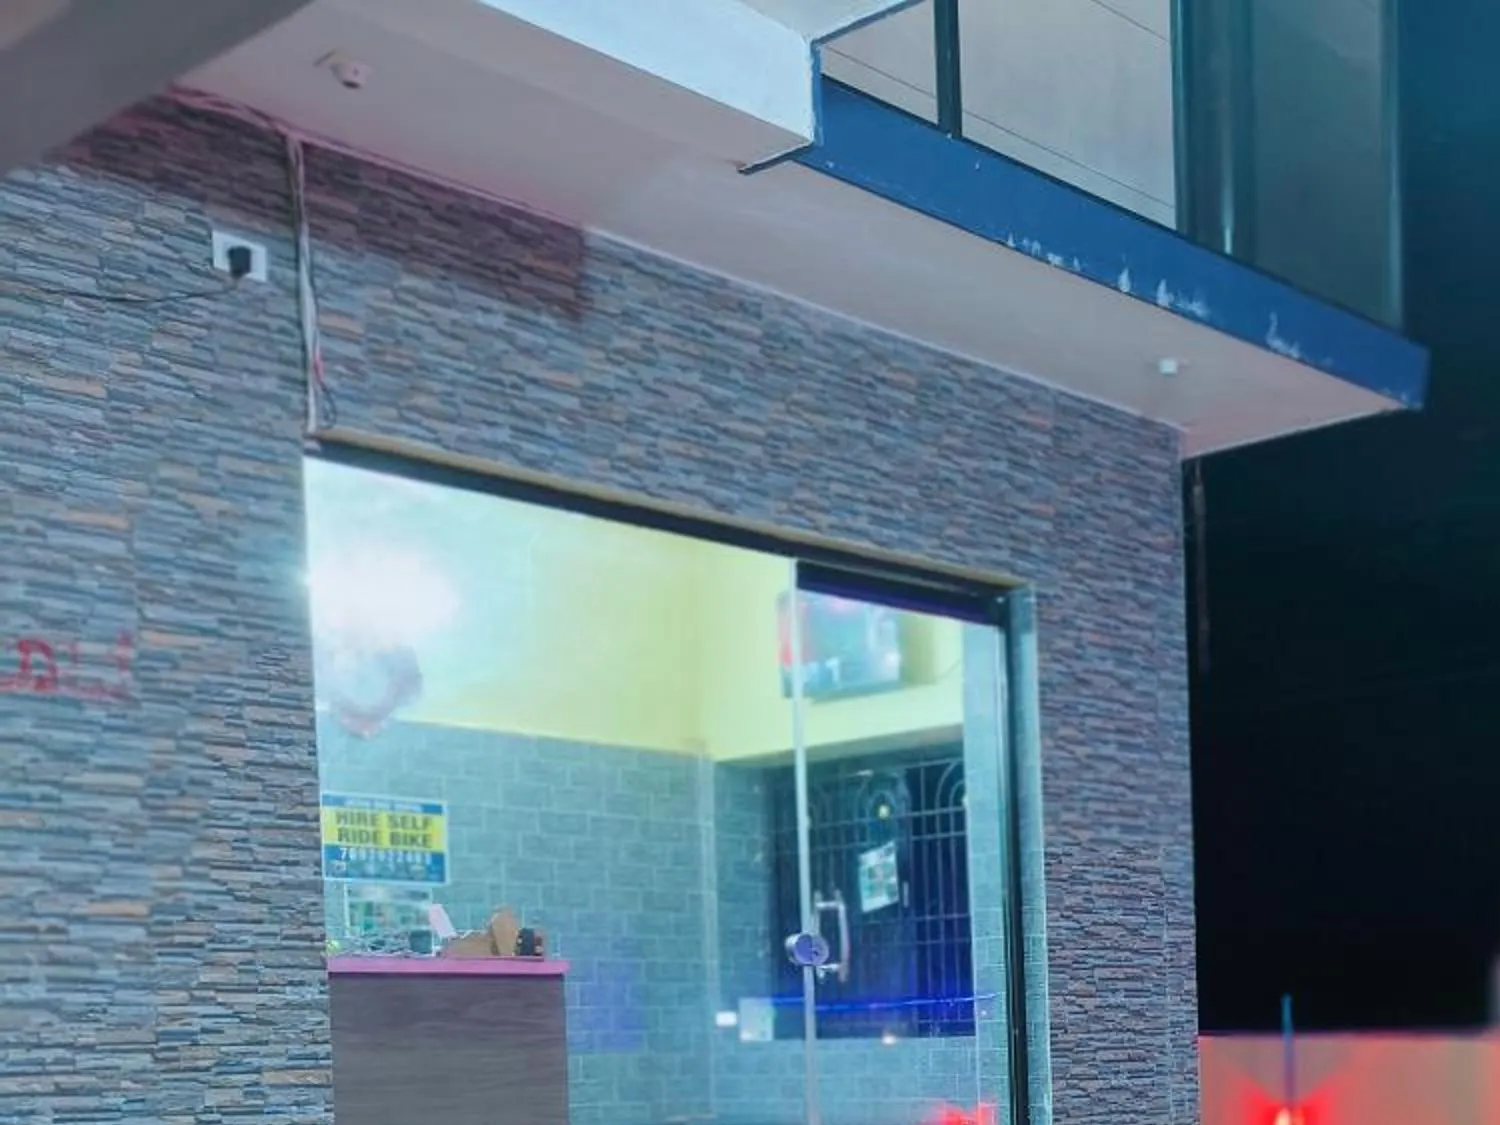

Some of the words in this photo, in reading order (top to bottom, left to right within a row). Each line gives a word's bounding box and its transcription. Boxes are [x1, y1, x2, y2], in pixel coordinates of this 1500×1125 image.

[335, 811, 381, 828] HIRE
[387, 814, 433, 830] SELF
[337, 828, 382, 845] RIDE
[389, 832, 433, 849] BIKE
